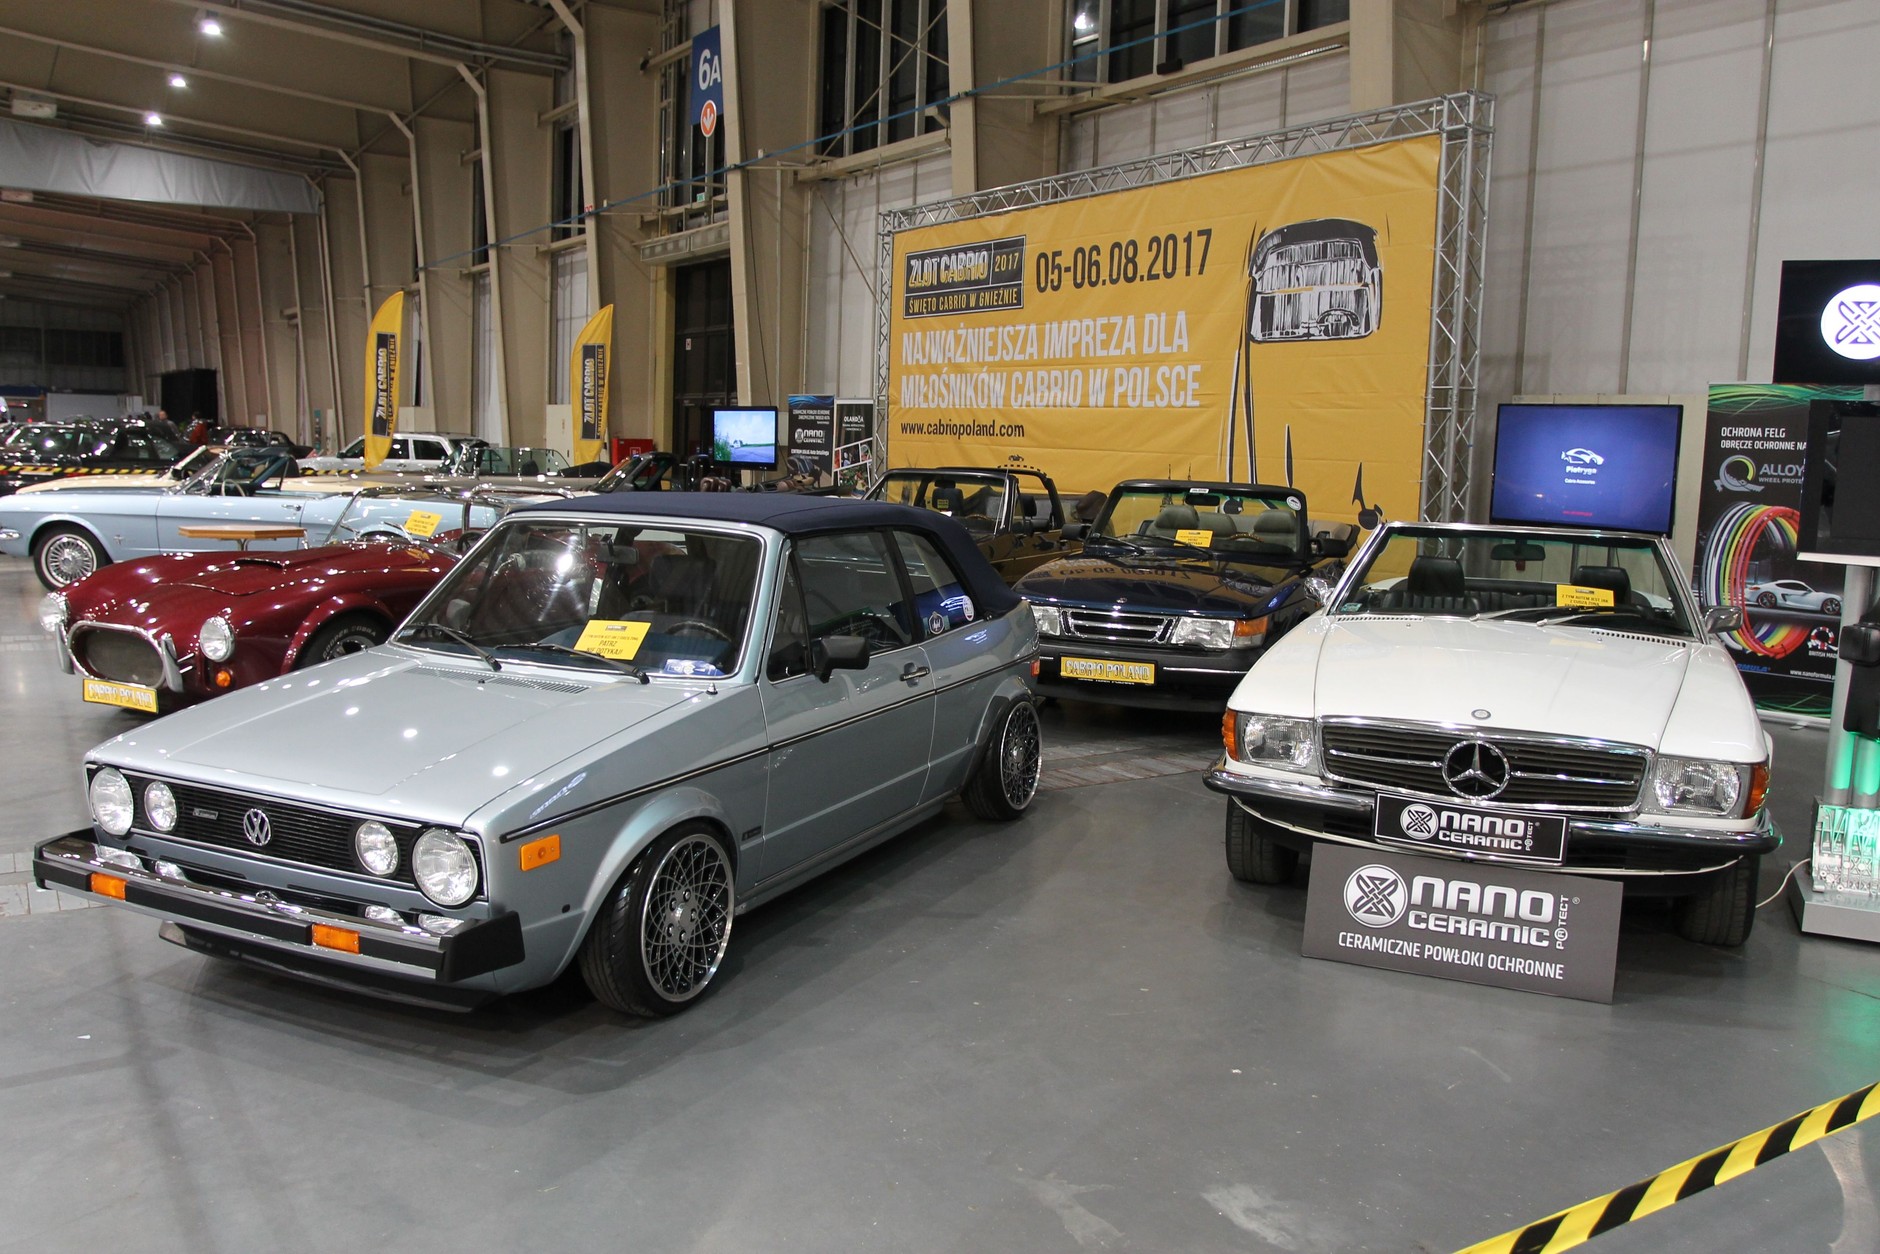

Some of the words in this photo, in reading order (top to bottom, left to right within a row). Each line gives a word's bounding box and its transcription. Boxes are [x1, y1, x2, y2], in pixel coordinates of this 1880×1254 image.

[698, 48, 721, 90] 6A
[909, 257, 939, 288] ZLOT
[940, 248, 988, 283] CABRIO
[995, 252, 1019, 272] 2017
[1036, 228, 1212, 293] 05-06.08.2017
[909, 296, 936, 315] ŚWIĘTO
[939, 294, 966, 311] CABRIO
[969, 293, 977, 308] W
[979, 287, 1018, 307] GNIEŹNIE
[902, 322, 1038, 365] NAJWAŻNIEJSZA
[1043, 315, 1136, 359] IMPREZA
[1143, 311, 1188, 354] DLA
[378, 348, 387, 390] CABRIO
[584, 358, 595, 396] CABRIO
[901, 366, 1007, 409] MIŁOŚNIKÓW
[1011, 369, 1083, 408] CABRIO
[1089, 368, 1109, 408] W
[1114, 365, 1201, 408] POLSCE
[803, 429, 823, 438] NANO
[901, 419, 1024, 440] www.cabriopoland.com
[1720, 440, 1753, 450] OBRĘCZE
[1754, 441, 1795, 450] OCHRONNE
[1721, 427, 1762, 438] OCHRONA
[1764, 427, 1786, 438] FELG
[1066, 660, 1104, 678] CABRIO
[1106, 664, 1150, 680] POLAND
[1438, 830, 1522, 850] CERAMIC
[1439, 810, 1525, 837] NANO
[1411, 875, 1554, 923] NANO
[1407, 910, 1550, 948] CERAMIC
[1338, 931, 1421, 958] CERAMICZNE
[1424, 944, 1484, 968] POWŁOKI
[1487, 953, 1565, 980] OCHRONNE
